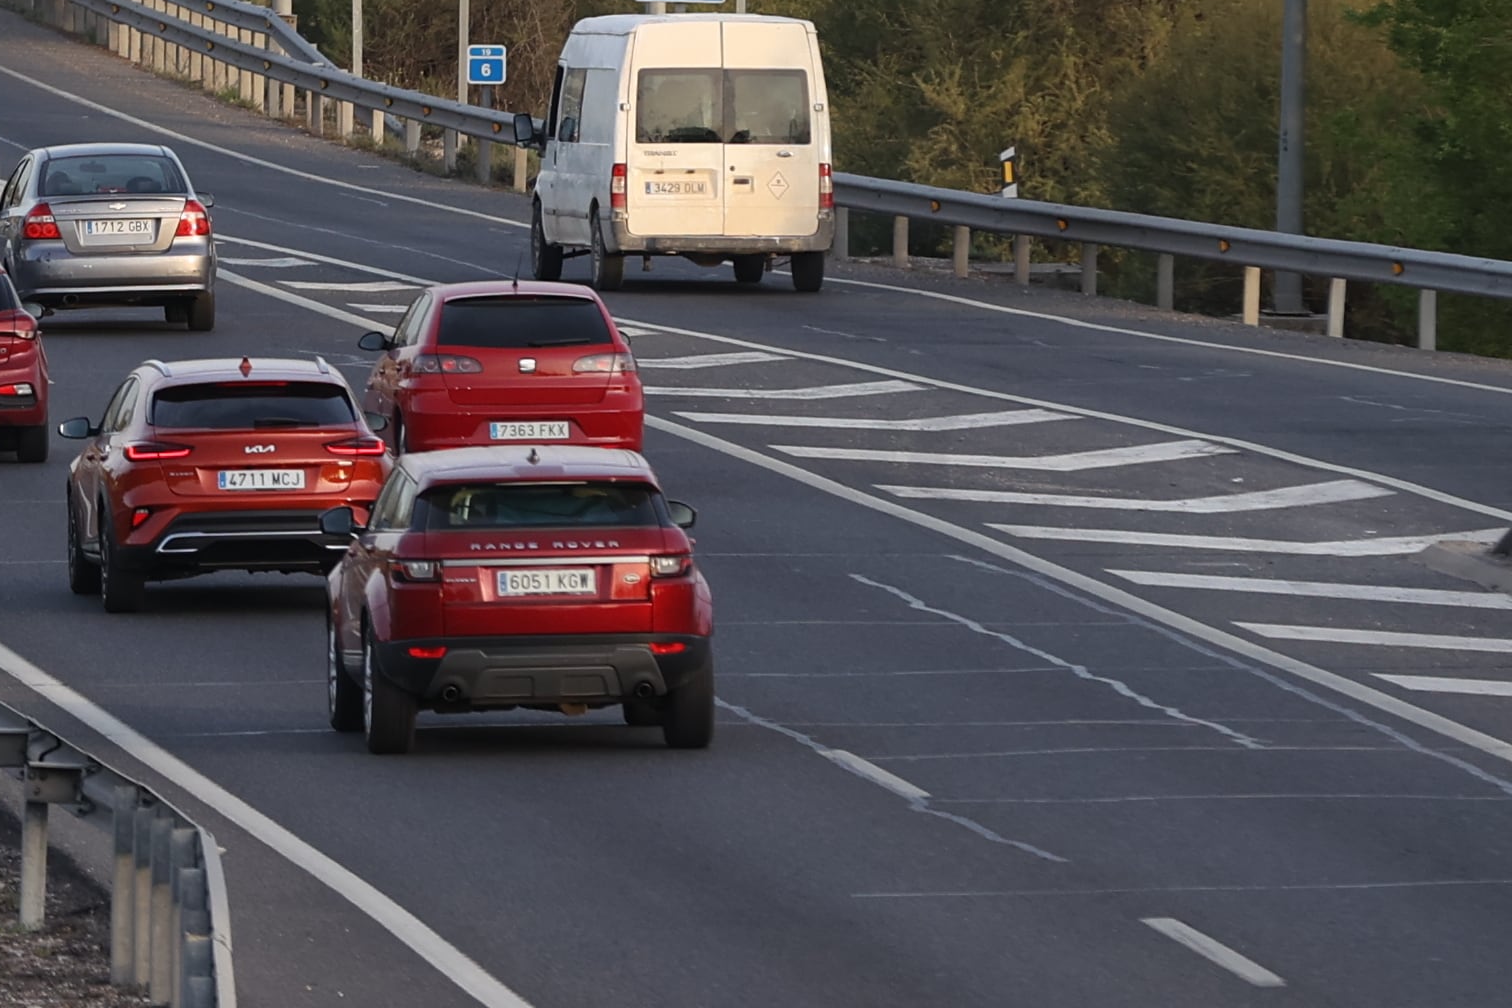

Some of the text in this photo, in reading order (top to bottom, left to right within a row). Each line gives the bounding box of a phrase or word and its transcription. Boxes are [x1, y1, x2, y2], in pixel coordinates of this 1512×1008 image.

[481, 63, 491, 77] 6
[654, 183, 680, 193] 3429
[95, 221, 149, 233] 1712 GBX
[501, 425, 566, 437] 7363 FKX
[229, 473, 300, 485] 4711 MCJ
[470, 540, 620, 551] RANGE ROVER
[510, 573, 589, 589] 6051 KGW
